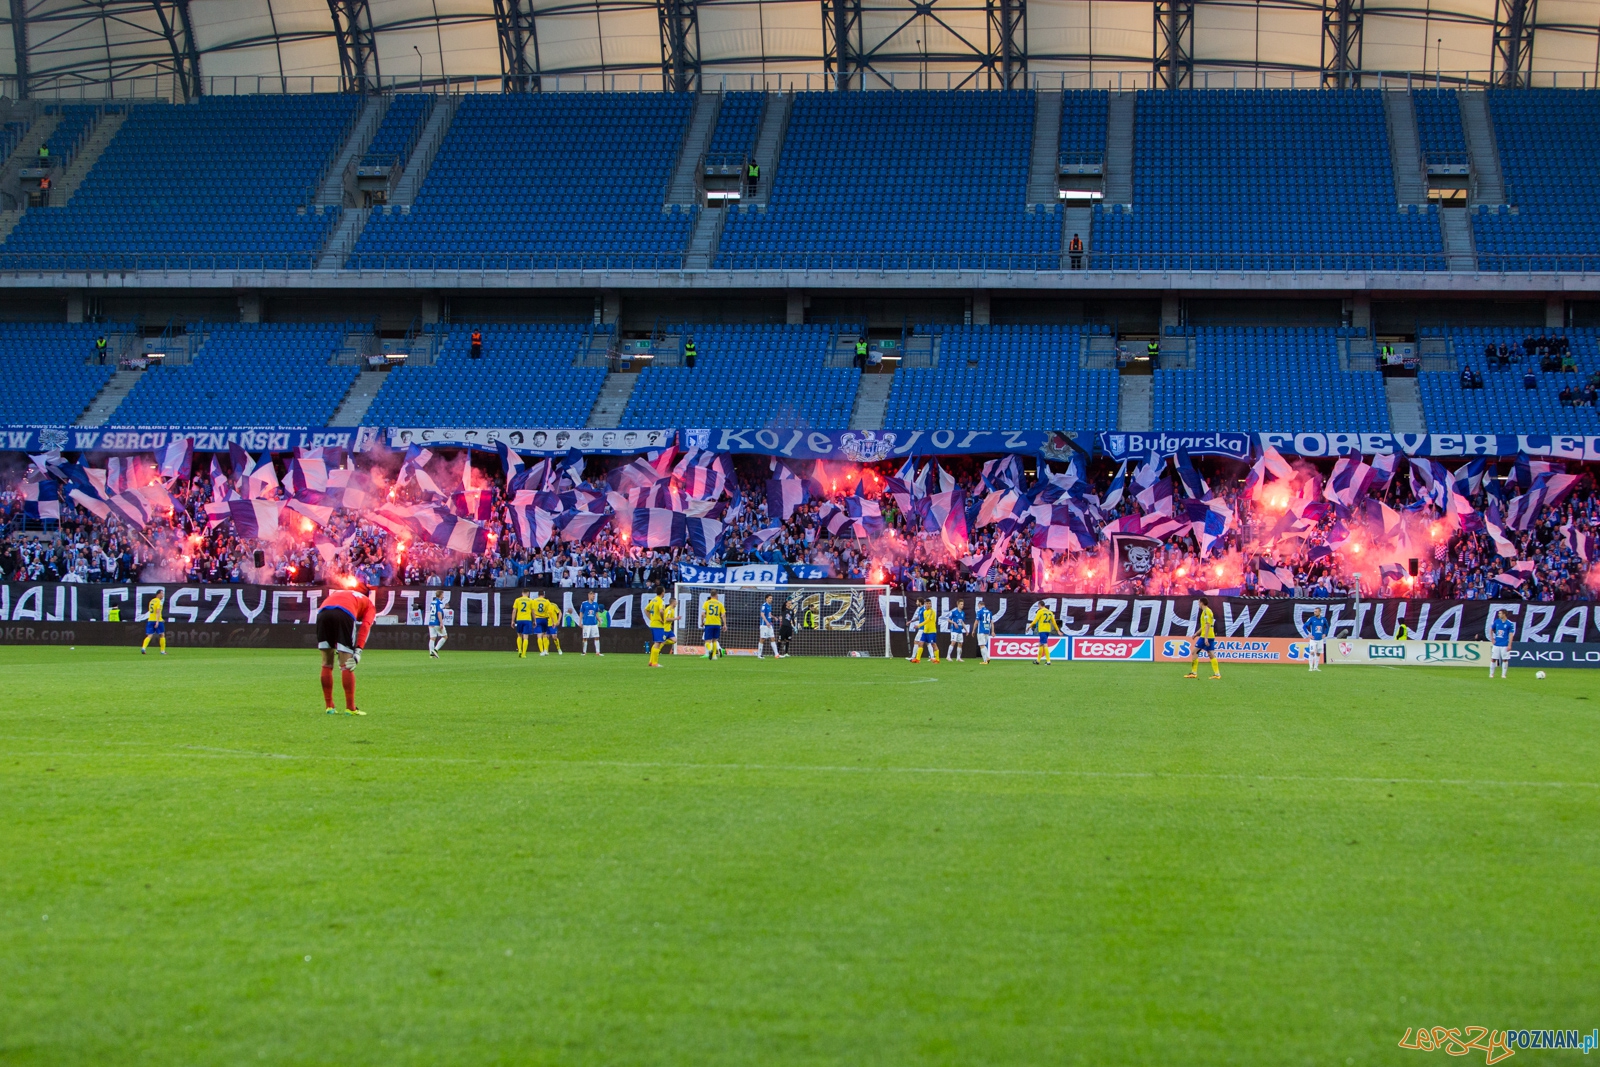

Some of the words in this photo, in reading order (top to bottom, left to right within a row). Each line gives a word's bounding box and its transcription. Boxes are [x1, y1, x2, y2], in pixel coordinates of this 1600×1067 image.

[75, 432, 100, 449] W
[101, 431, 168, 449] SERCU
[299, 432, 351, 450] LECH
[1129, 433, 1242, 453] Bułgarska
[1258, 432, 1498, 457] FOREVER
[521, 602, 527, 612] 2
[538, 603, 544, 613] 8
[708, 604, 719, 616] 51
[983, 612, 991, 623] 14
[1025, 597, 1200, 637] SEZON
[1223, 602, 1269, 638] W
[1485, 603, 1600, 643] GRA
[994, 639, 1042, 656] tesa
[1078, 640, 1127, 657] tesa
[1162, 639, 1191, 658] STS
[1213, 641, 1270, 651] ZAKŁADY
[1371, 646, 1403, 657] LECH
[1422, 642, 1481, 661] PILS
[1508, 650, 1564, 661] PAKO
